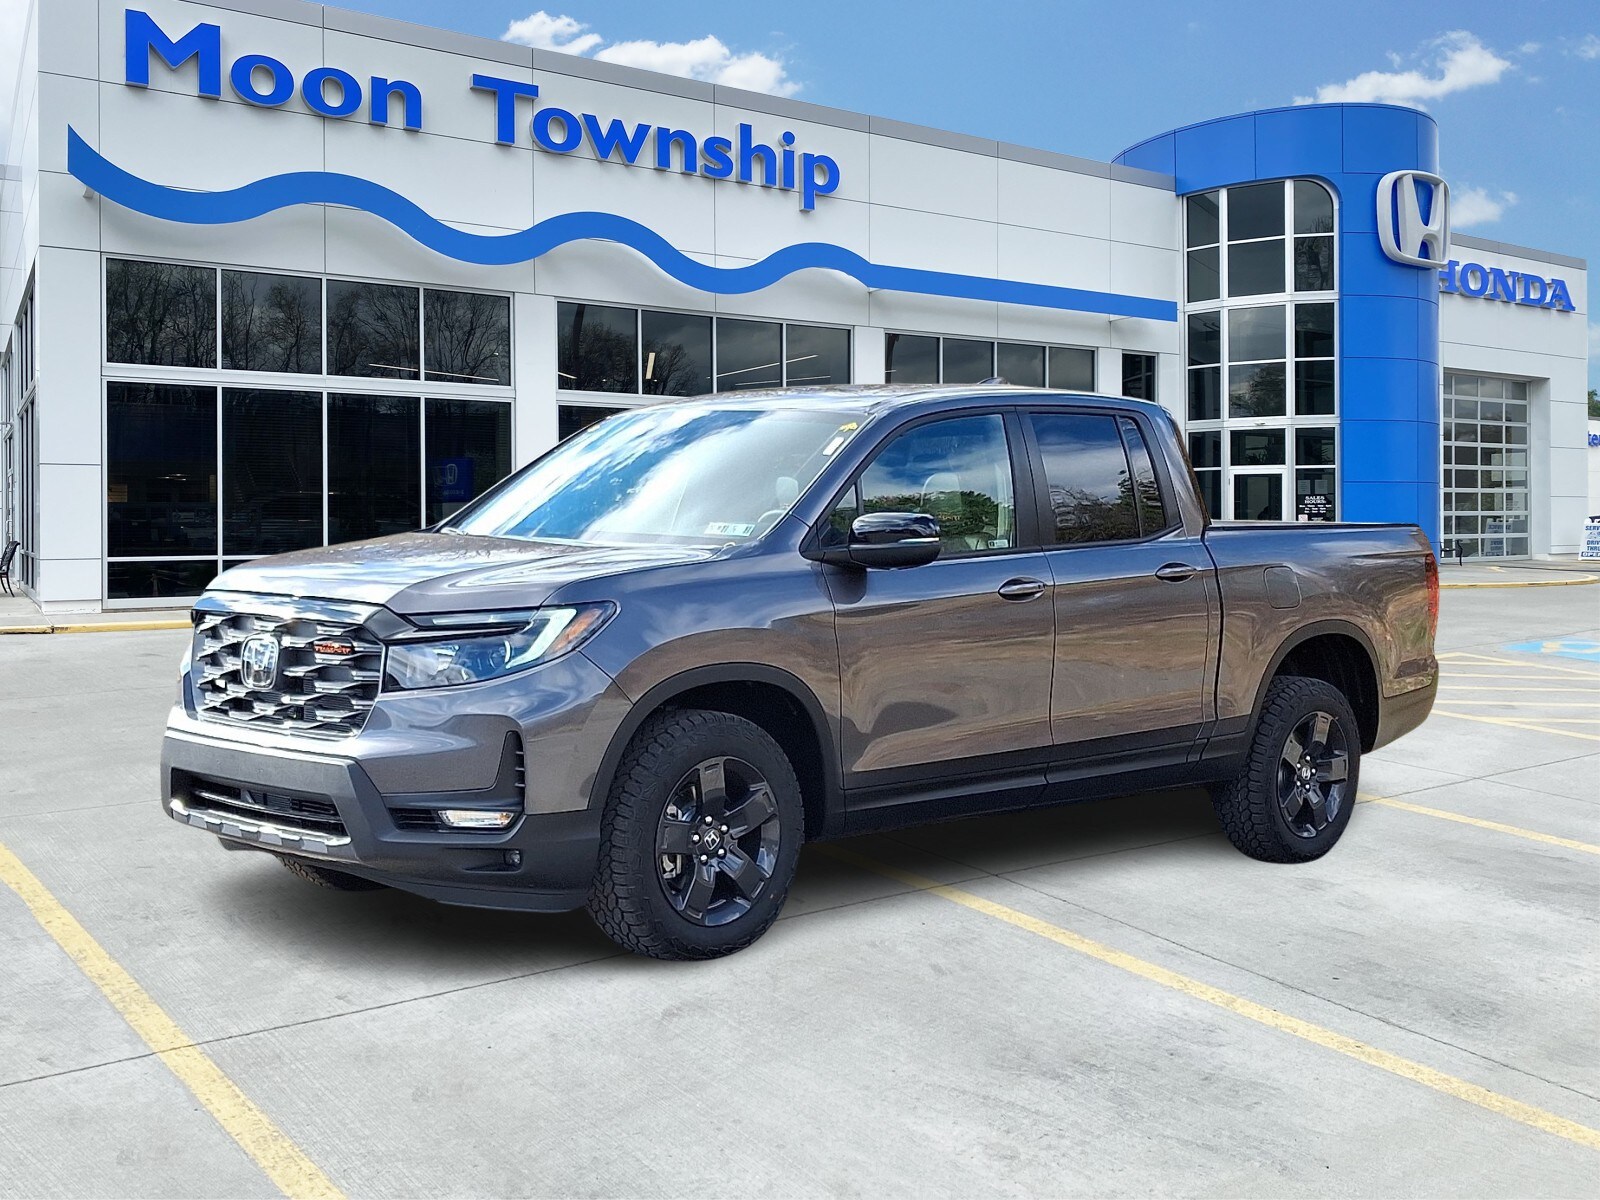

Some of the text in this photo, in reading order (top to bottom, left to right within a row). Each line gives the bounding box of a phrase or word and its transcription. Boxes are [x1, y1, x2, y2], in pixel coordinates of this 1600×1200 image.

[125, 9, 841, 212] Moon Township
[1439, 260, 1576, 311] HONDA
